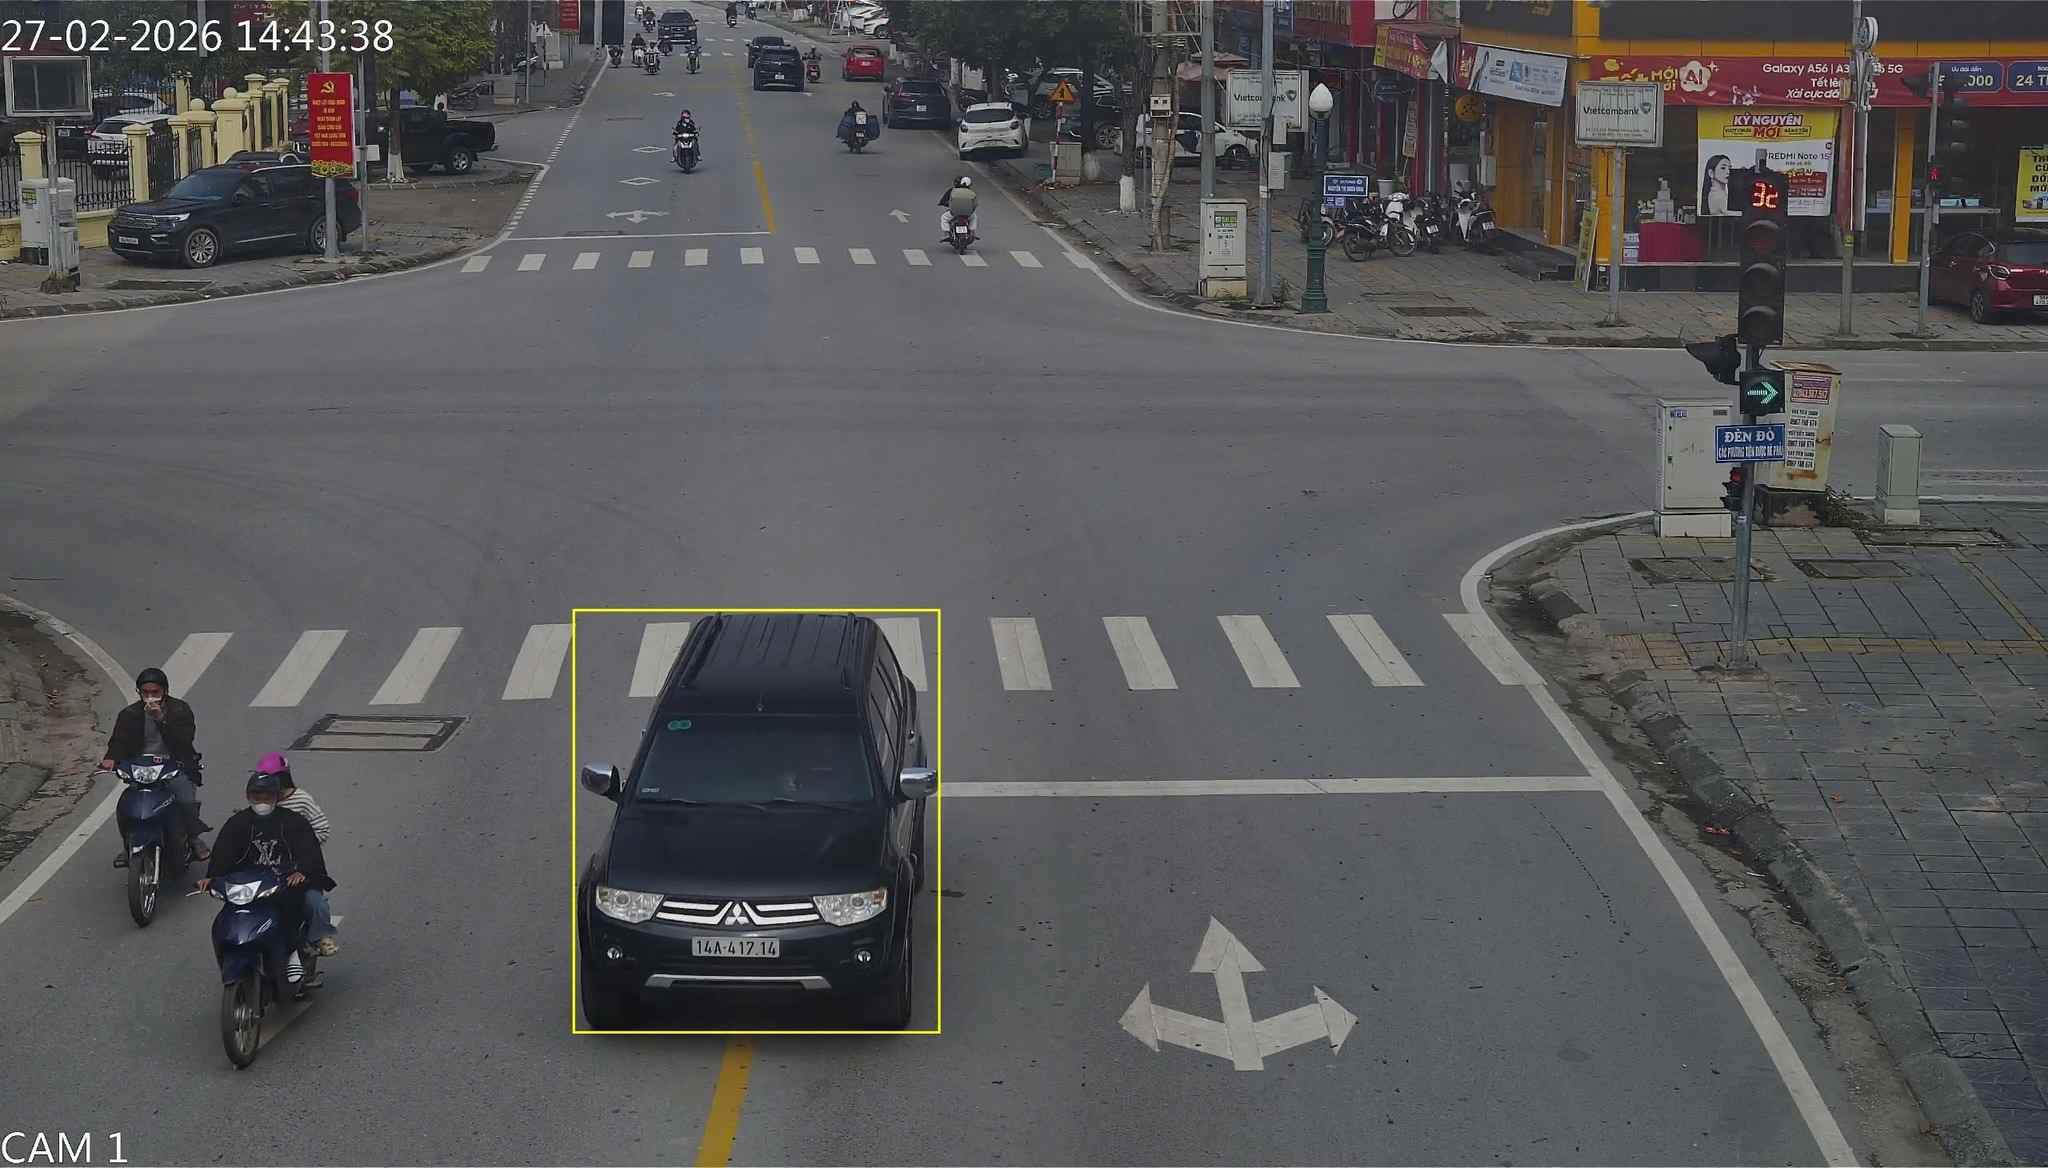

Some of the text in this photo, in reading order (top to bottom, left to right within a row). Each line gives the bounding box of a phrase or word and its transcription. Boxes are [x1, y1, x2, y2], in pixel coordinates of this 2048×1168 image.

[1762, 63, 1804, 75] Galaxy
[1807, 63, 1828, 73] A56
[1836, 63, 1849, 73] A3
[1887, 64, 1904, 74] 5G
[2016, 74, 2034, 87] 24
[1583, 105, 1639, 115] Vietcombank
[1752, 112, 1803, 126] NGUYÊN
[1769, 152, 1796, 160] REDMI
[1797, 152, 1818, 160] Note
[1725, 428, 1752, 443] ĐÈN
[1756, 426, 1775, 442] ĐỎ
